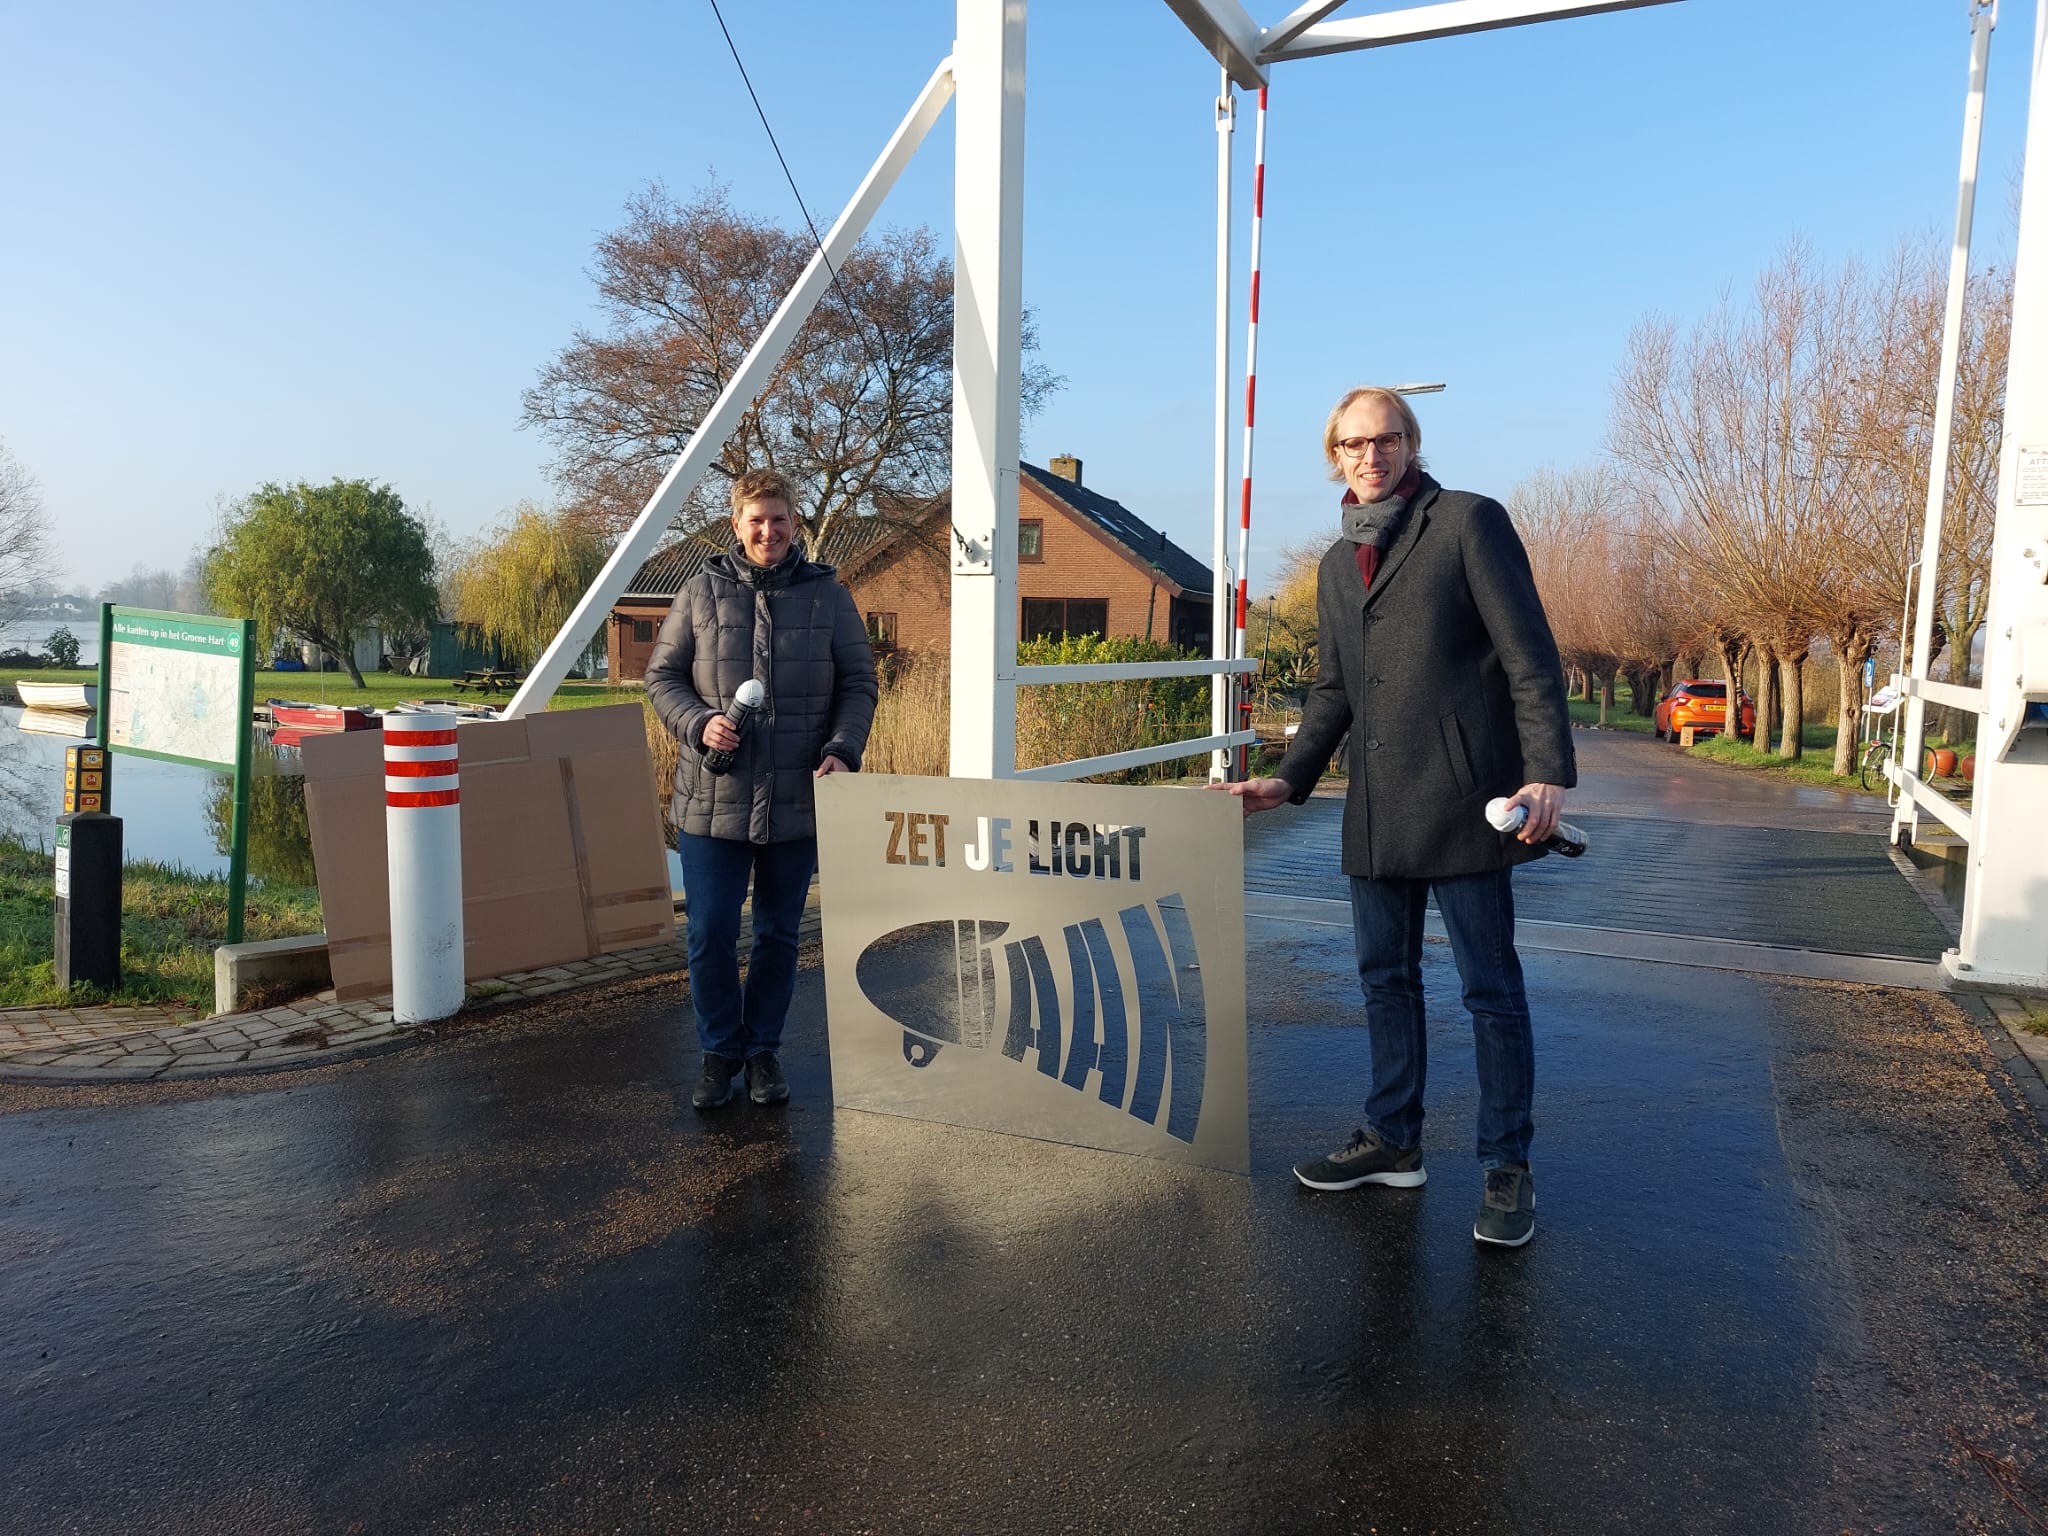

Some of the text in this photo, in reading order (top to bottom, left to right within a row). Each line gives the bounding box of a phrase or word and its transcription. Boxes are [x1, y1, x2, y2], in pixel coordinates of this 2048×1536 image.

[113, 623, 225, 646] Alle kanten op in het Groene Hart
[885, 811, 1146, 881] ZET JE LICHT
[1001, 892, 1208, 1145] AAN
